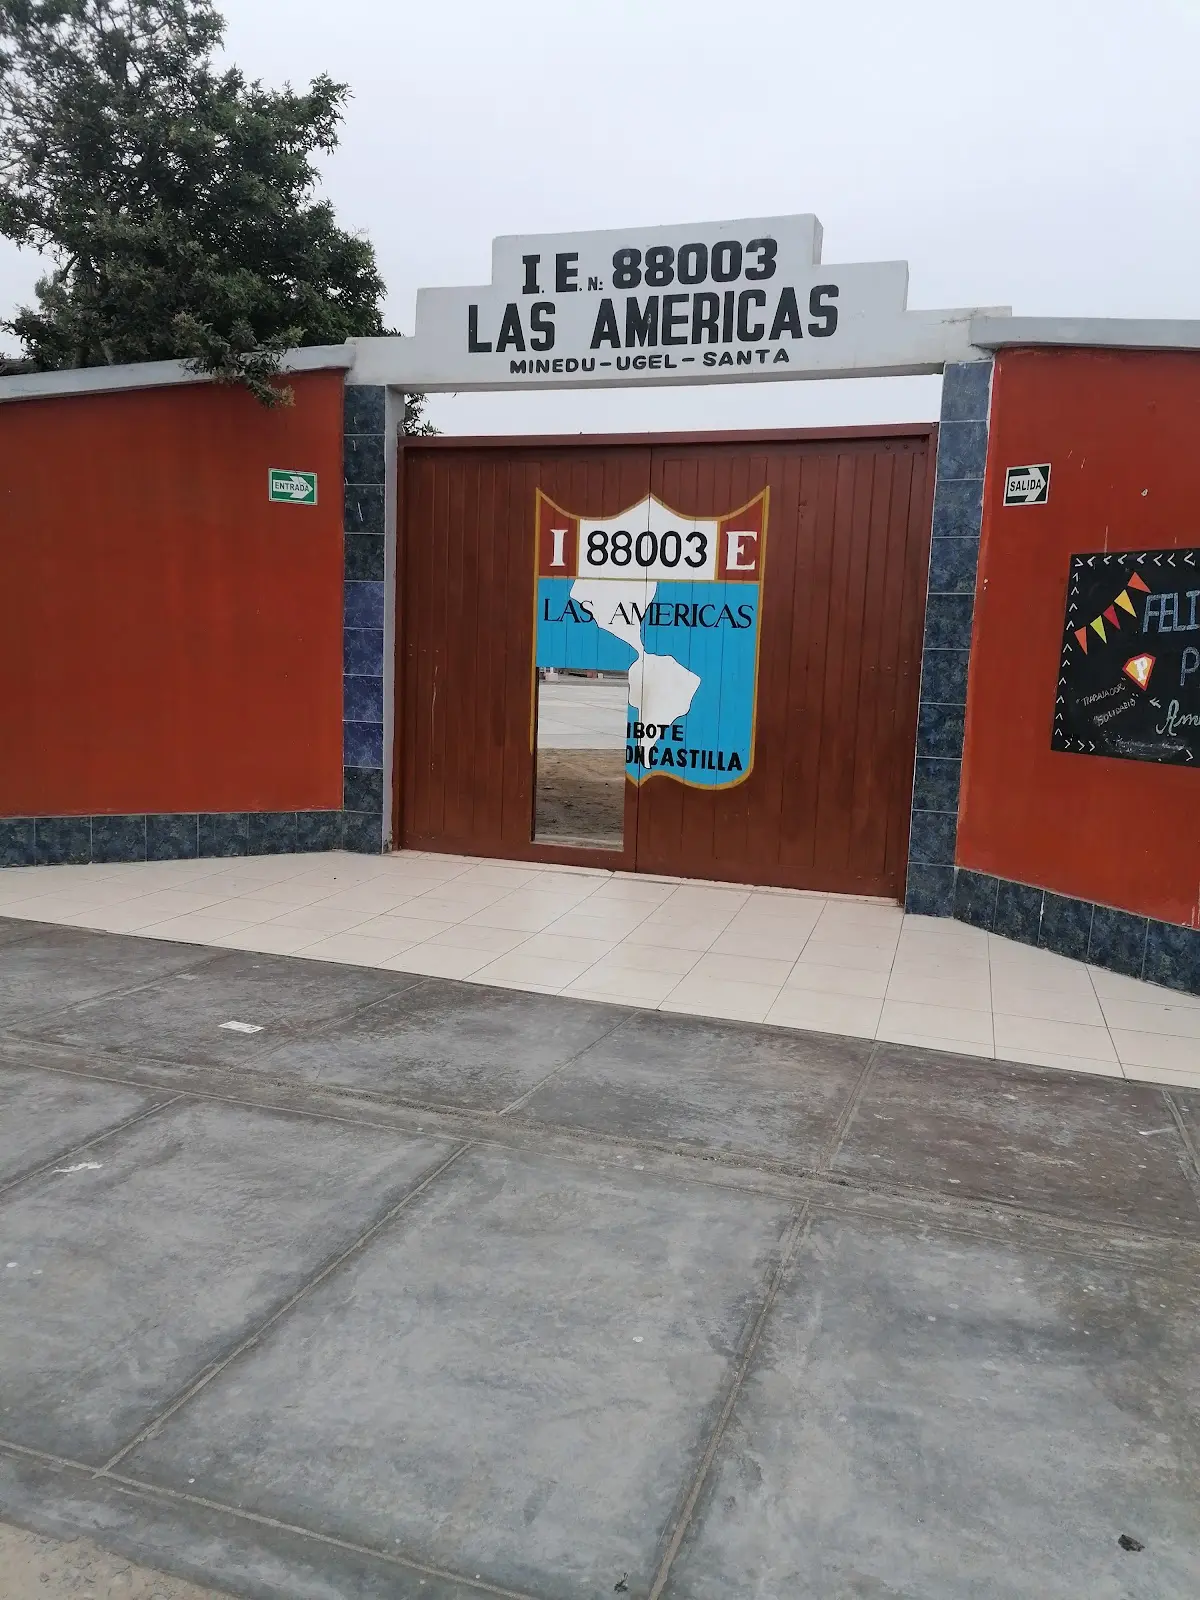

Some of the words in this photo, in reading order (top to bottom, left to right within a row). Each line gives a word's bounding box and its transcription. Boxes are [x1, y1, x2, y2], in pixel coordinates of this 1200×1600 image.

[612, 238, 778, 290] 88003
[468, 302, 556, 354] LAS
[589, 284, 840, 351] AMERICAS
[274, 481, 310, 492] ENTRADA
[1009, 479, 1042, 492] SALIDA
[550, 529, 569, 567] I
[586, 530, 708, 568] 88003
[725, 530, 758, 571] E
[543, 598, 594, 623] LAS
[608, 600, 755, 629] AMERICAS
[649, 746, 743, 771] CASTILLA
